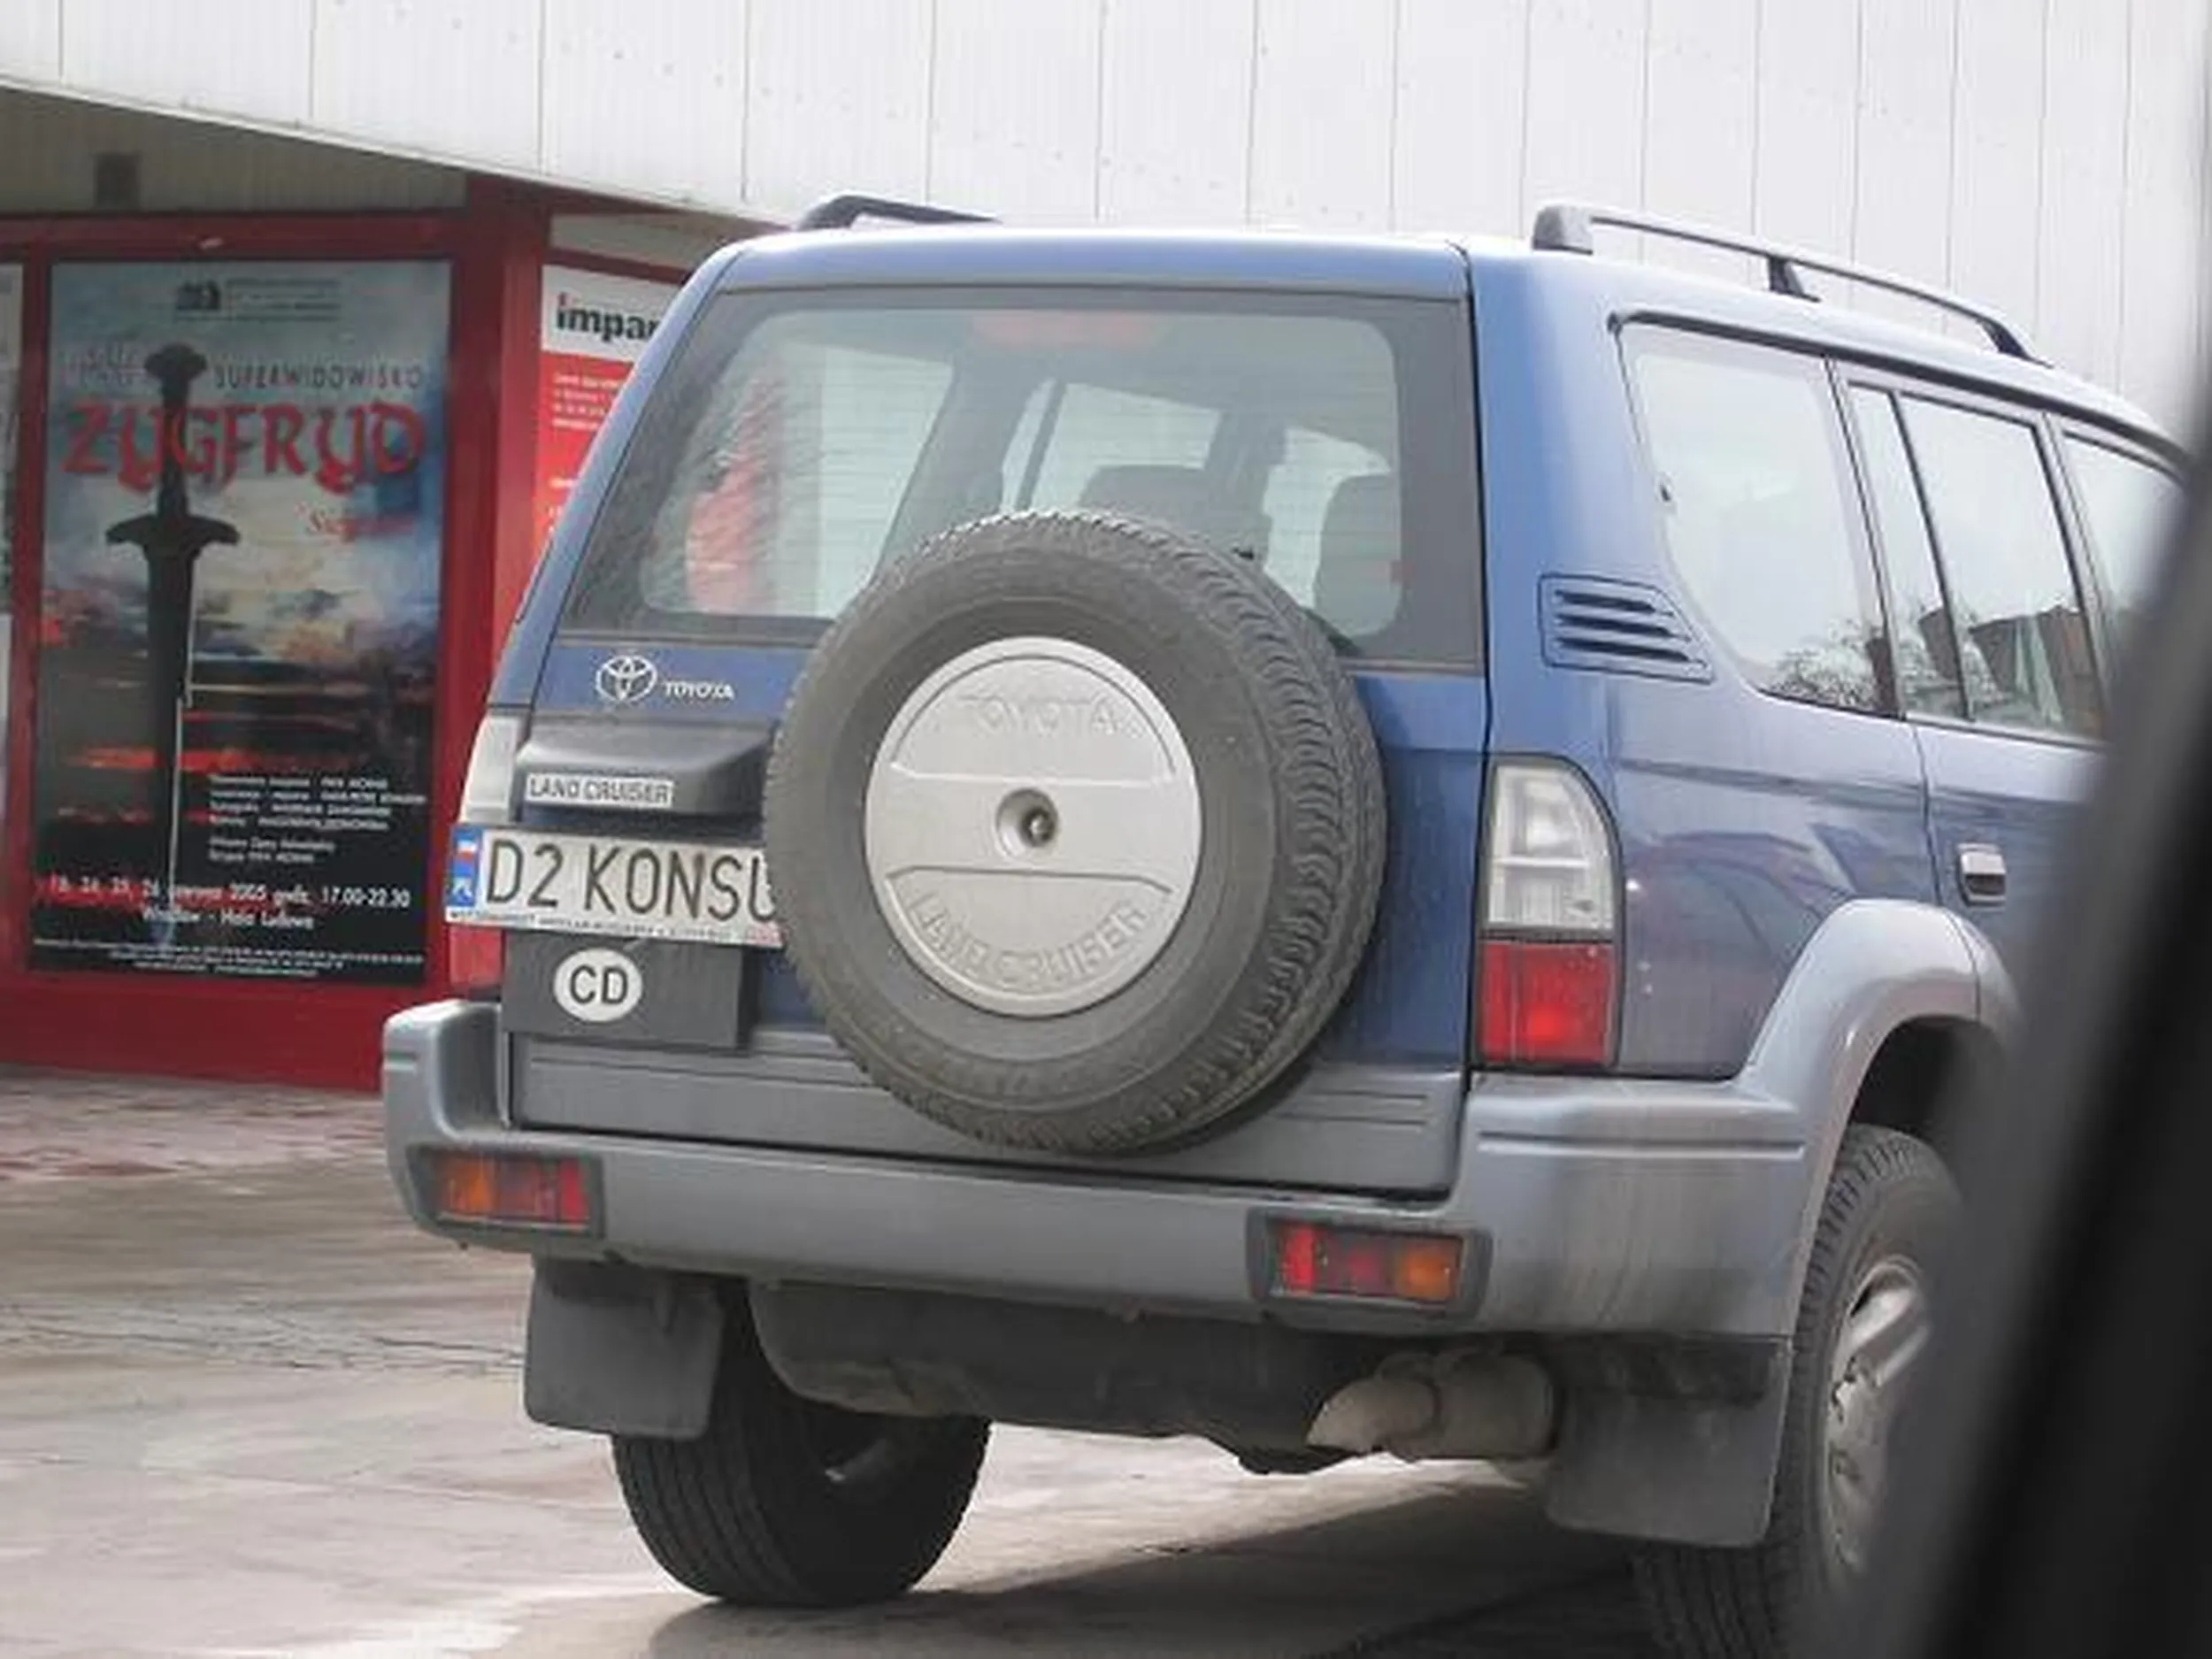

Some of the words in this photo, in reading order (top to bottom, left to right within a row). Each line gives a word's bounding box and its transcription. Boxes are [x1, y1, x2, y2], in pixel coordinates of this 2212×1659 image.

[664, 680, 736, 702] TOYOTA
[957, 692, 1129, 738] TOYOTA
[530, 774, 580, 798] LAND
[582, 777, 671, 804] CRUISER
[488, 839, 564, 908] D2
[569, 964, 627, 1004] CD
